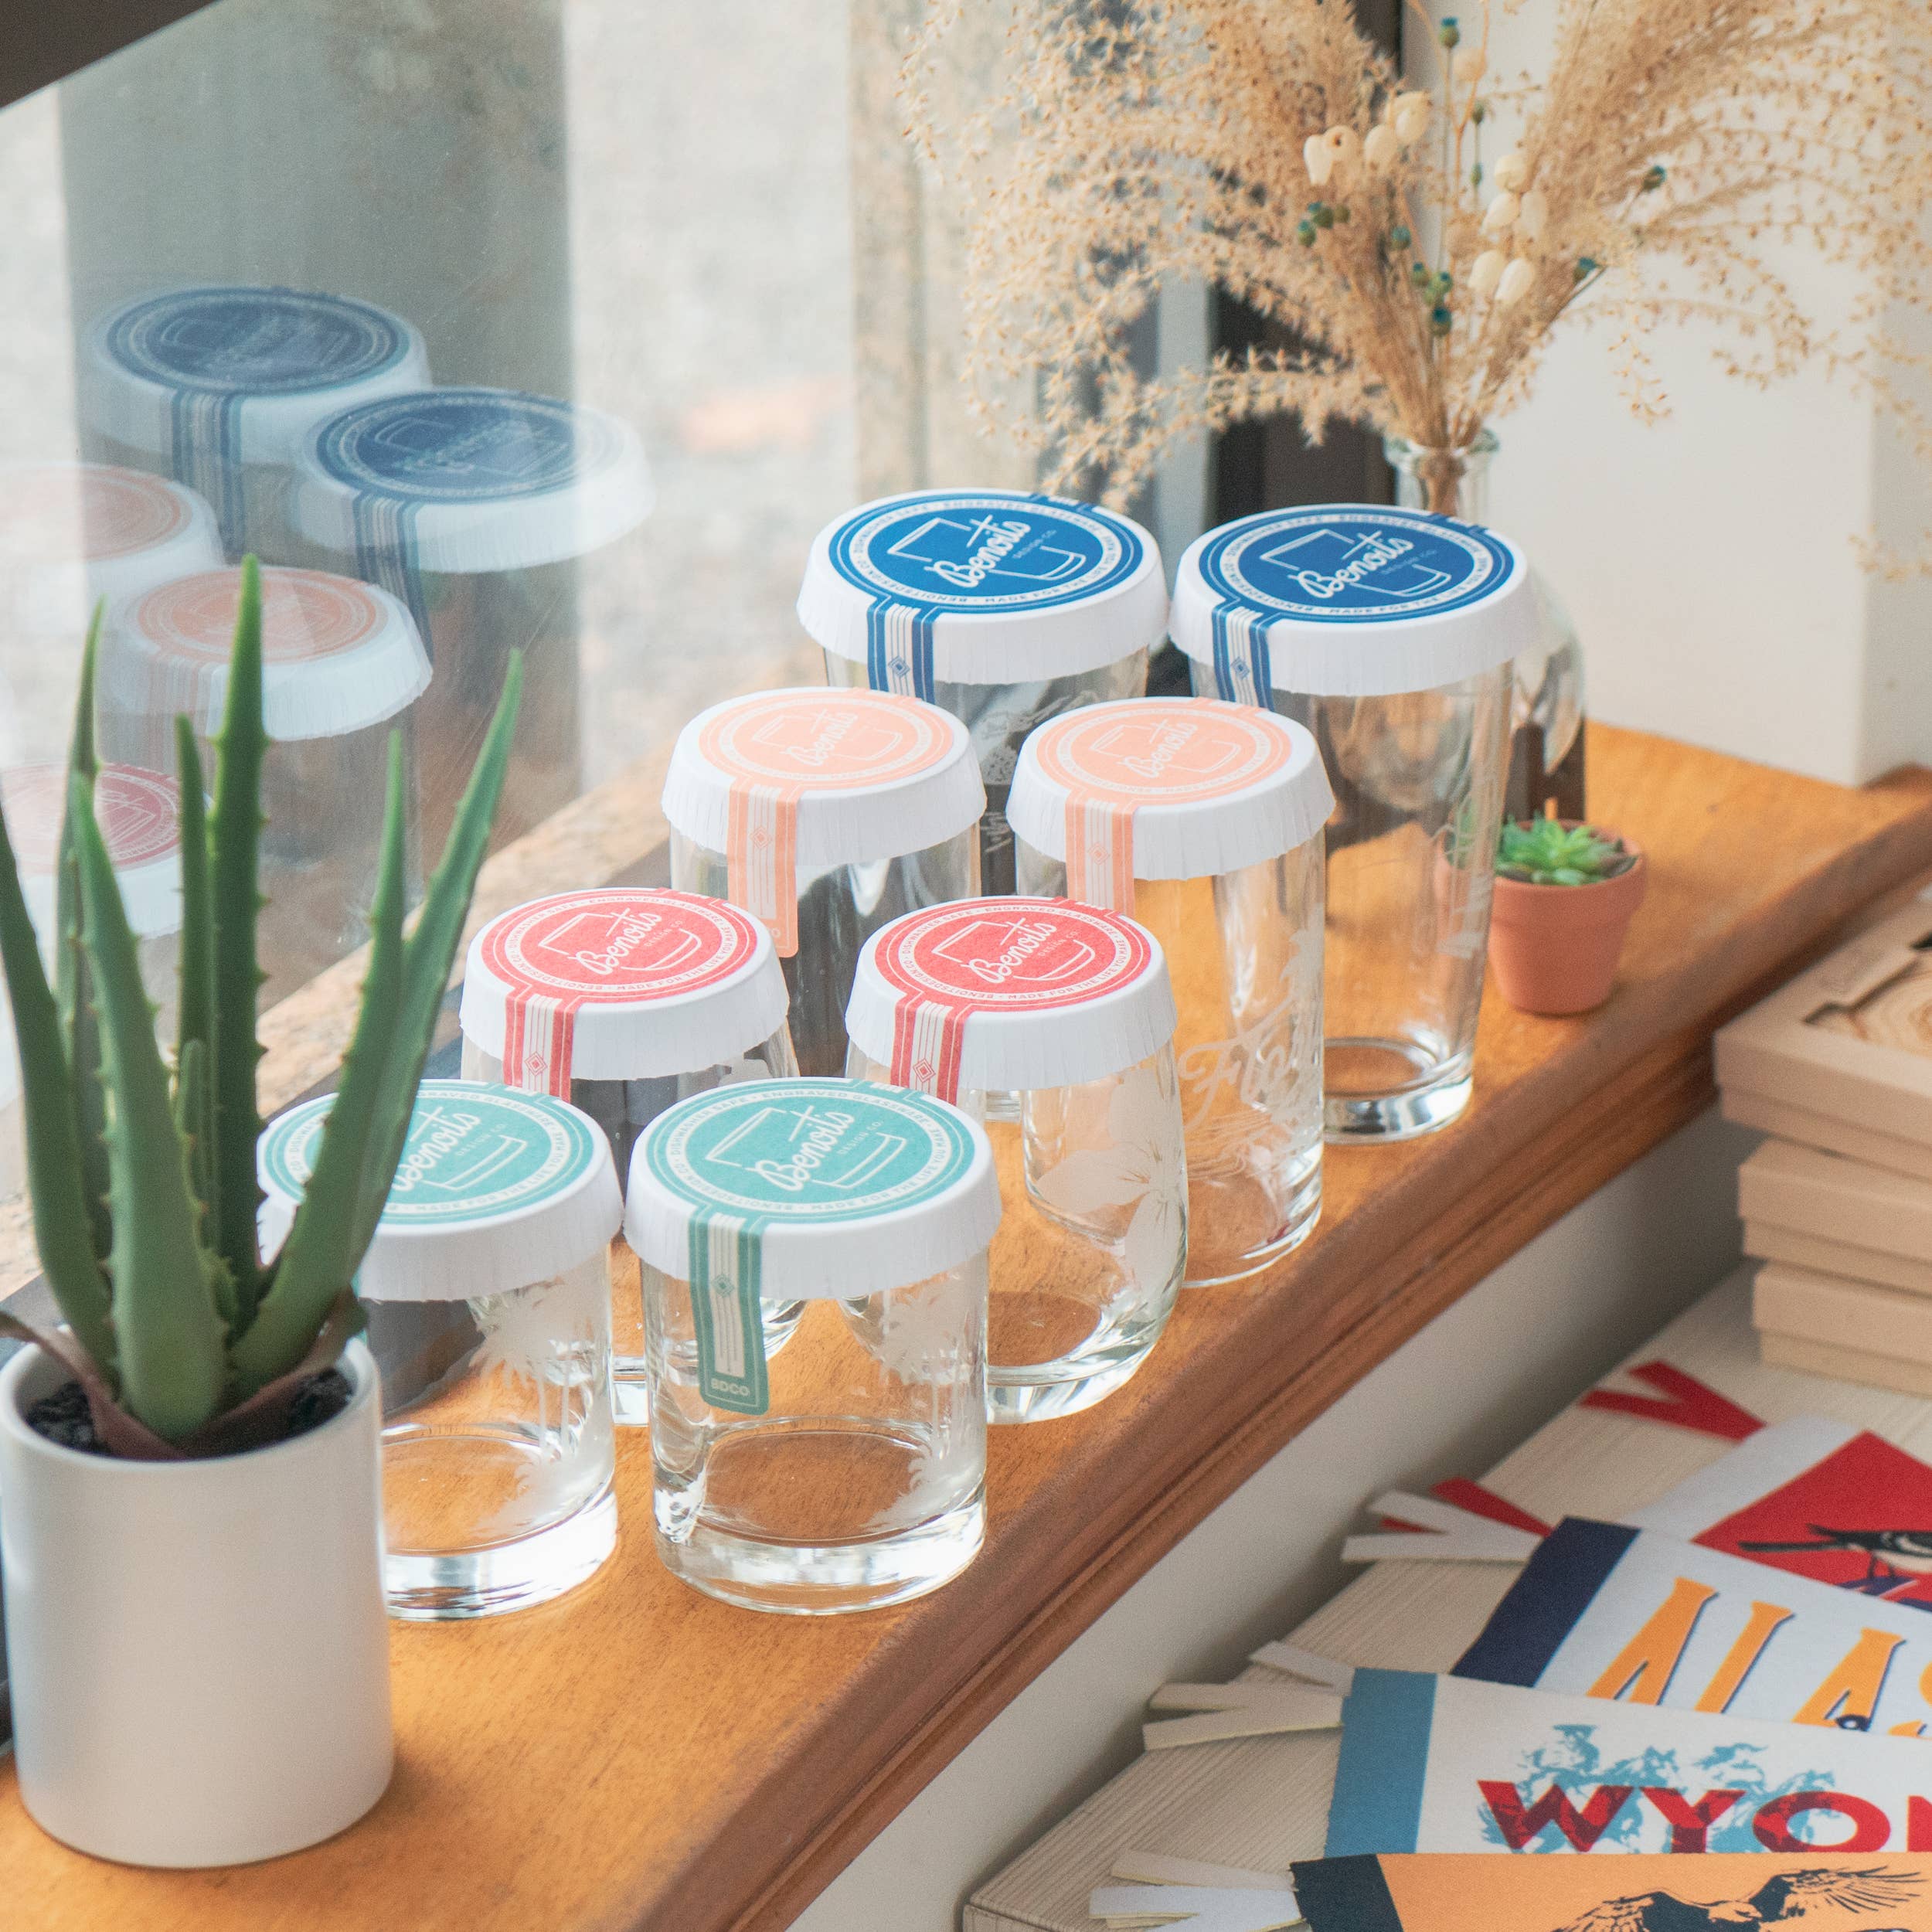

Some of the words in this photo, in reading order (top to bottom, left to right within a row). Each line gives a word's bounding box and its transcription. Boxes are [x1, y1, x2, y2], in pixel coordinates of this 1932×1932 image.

[656, 976, 683, 986] FOR
[1048, 987, 1075, 996] FOR
[1074, 978, 1100, 990] THE
[1096, 967, 1117, 980] LIFE
[1111, 955, 1126, 968] YOU
[1586, 1577, 1932, 1740] ALA
